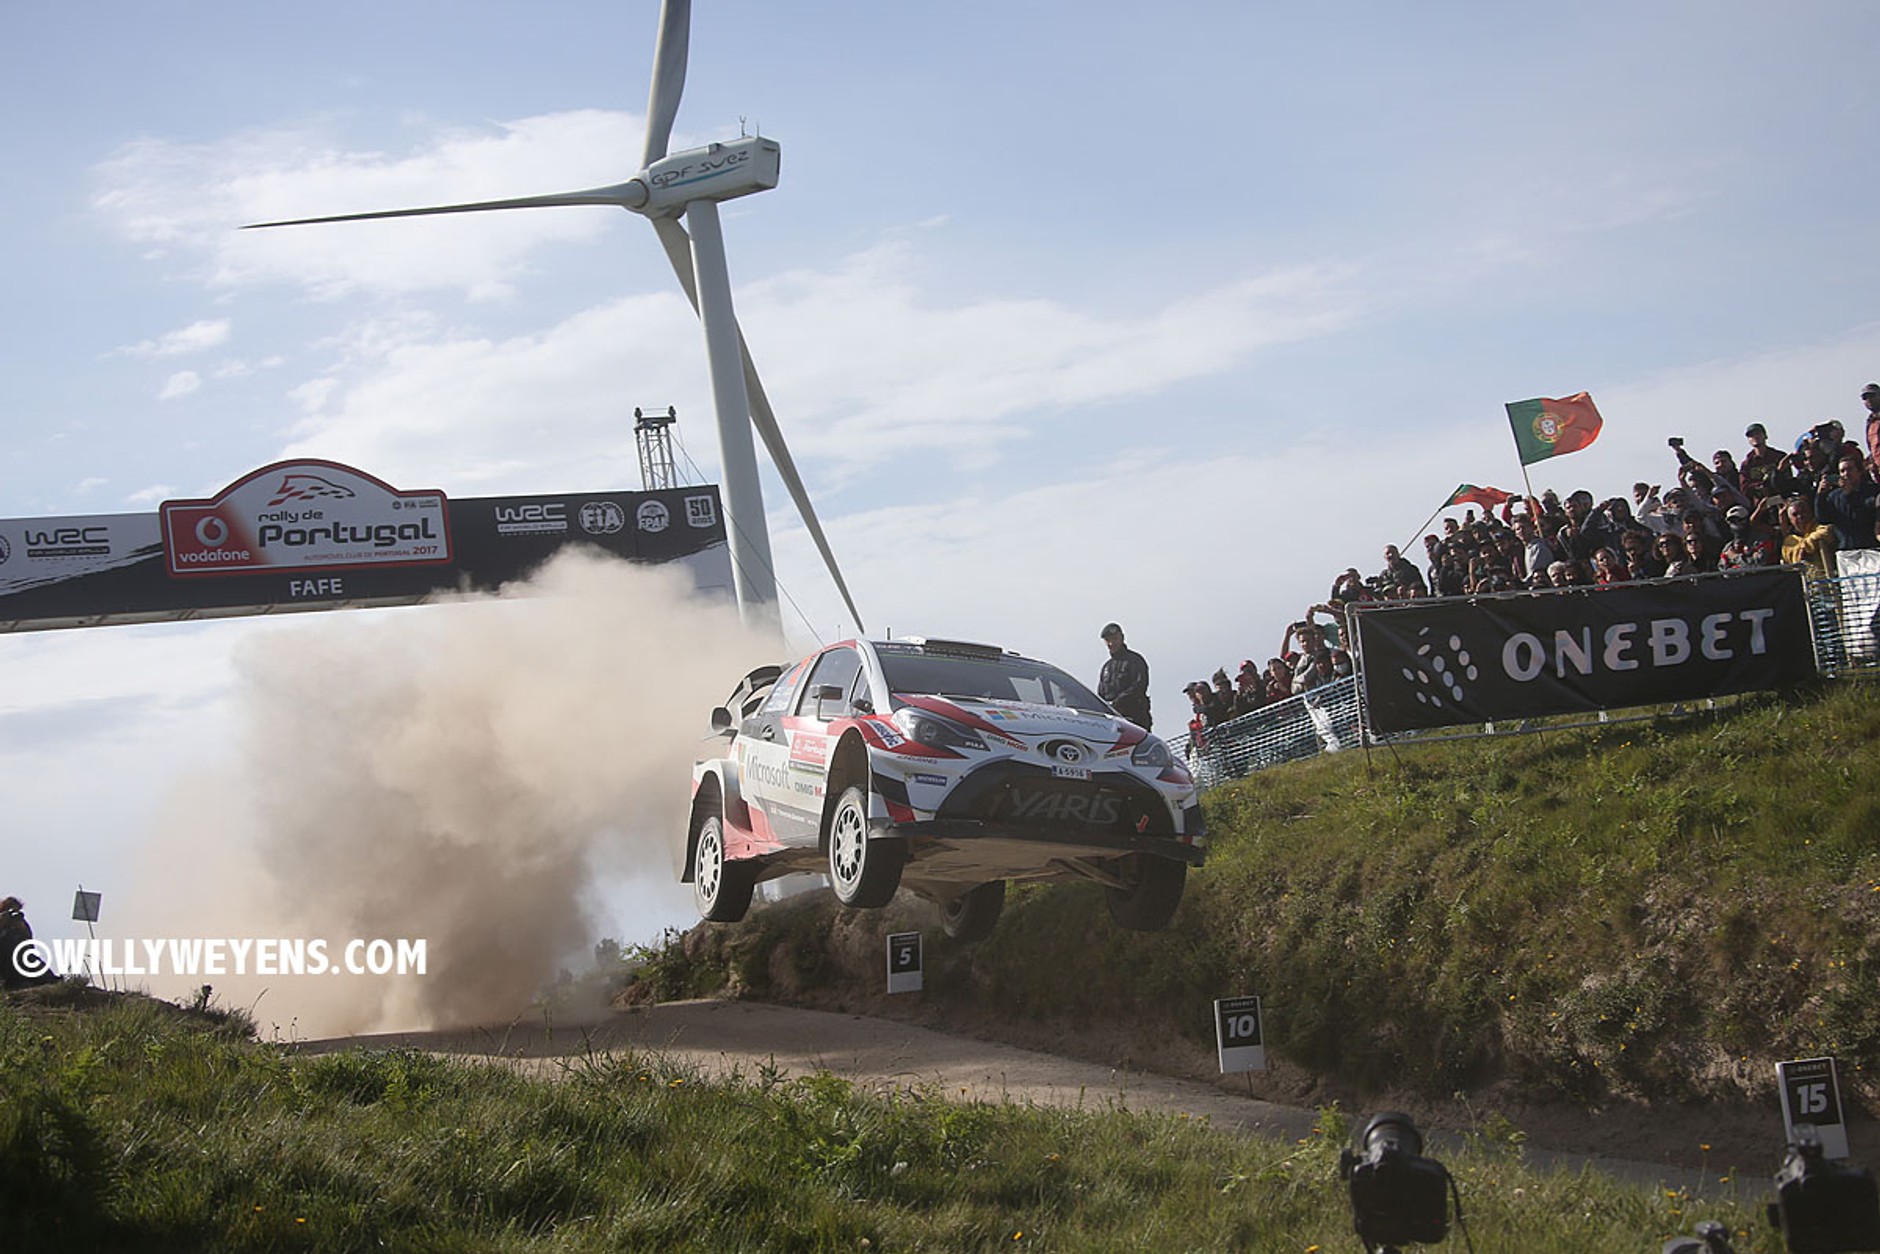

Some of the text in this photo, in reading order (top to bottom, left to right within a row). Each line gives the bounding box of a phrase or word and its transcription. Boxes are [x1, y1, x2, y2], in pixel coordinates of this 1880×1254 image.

[651, 166, 693, 187] GDF
[258, 509, 324, 523] rally de
[495, 503, 566, 521] WRC
[688, 499, 711, 516] 50
[25, 526, 110, 546] WRC
[259, 517, 437, 548] Portugal
[180, 549, 250, 562] vodafone
[413, 546, 438, 555] 2017
[290, 578, 343, 597] FAFE
[1502, 607, 1775, 682] ONEBET
[745, 754, 791, 790] Microsoft
[899, 947, 912, 965] 5
[1227, 1014, 1256, 1038] 10
[1796, 1083, 1828, 1115] 15
